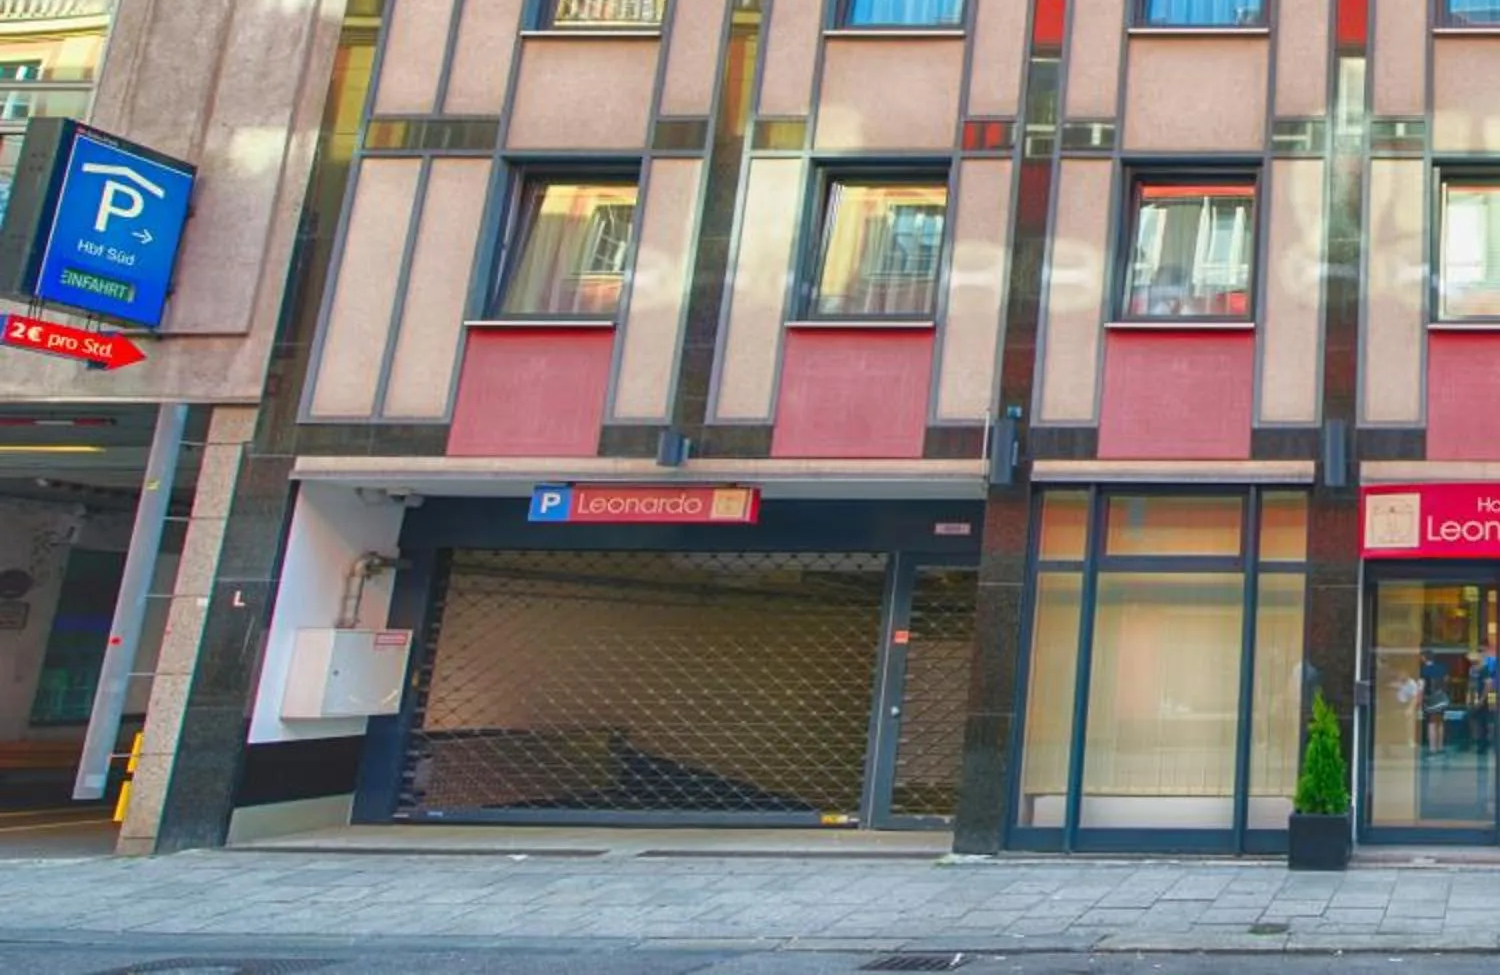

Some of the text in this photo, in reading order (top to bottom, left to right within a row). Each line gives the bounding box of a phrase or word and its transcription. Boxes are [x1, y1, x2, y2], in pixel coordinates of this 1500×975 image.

[94, 180, 145, 232] P
[48, 333, 78, 350] pro
[540, 492, 703, 515] P Leonardo
